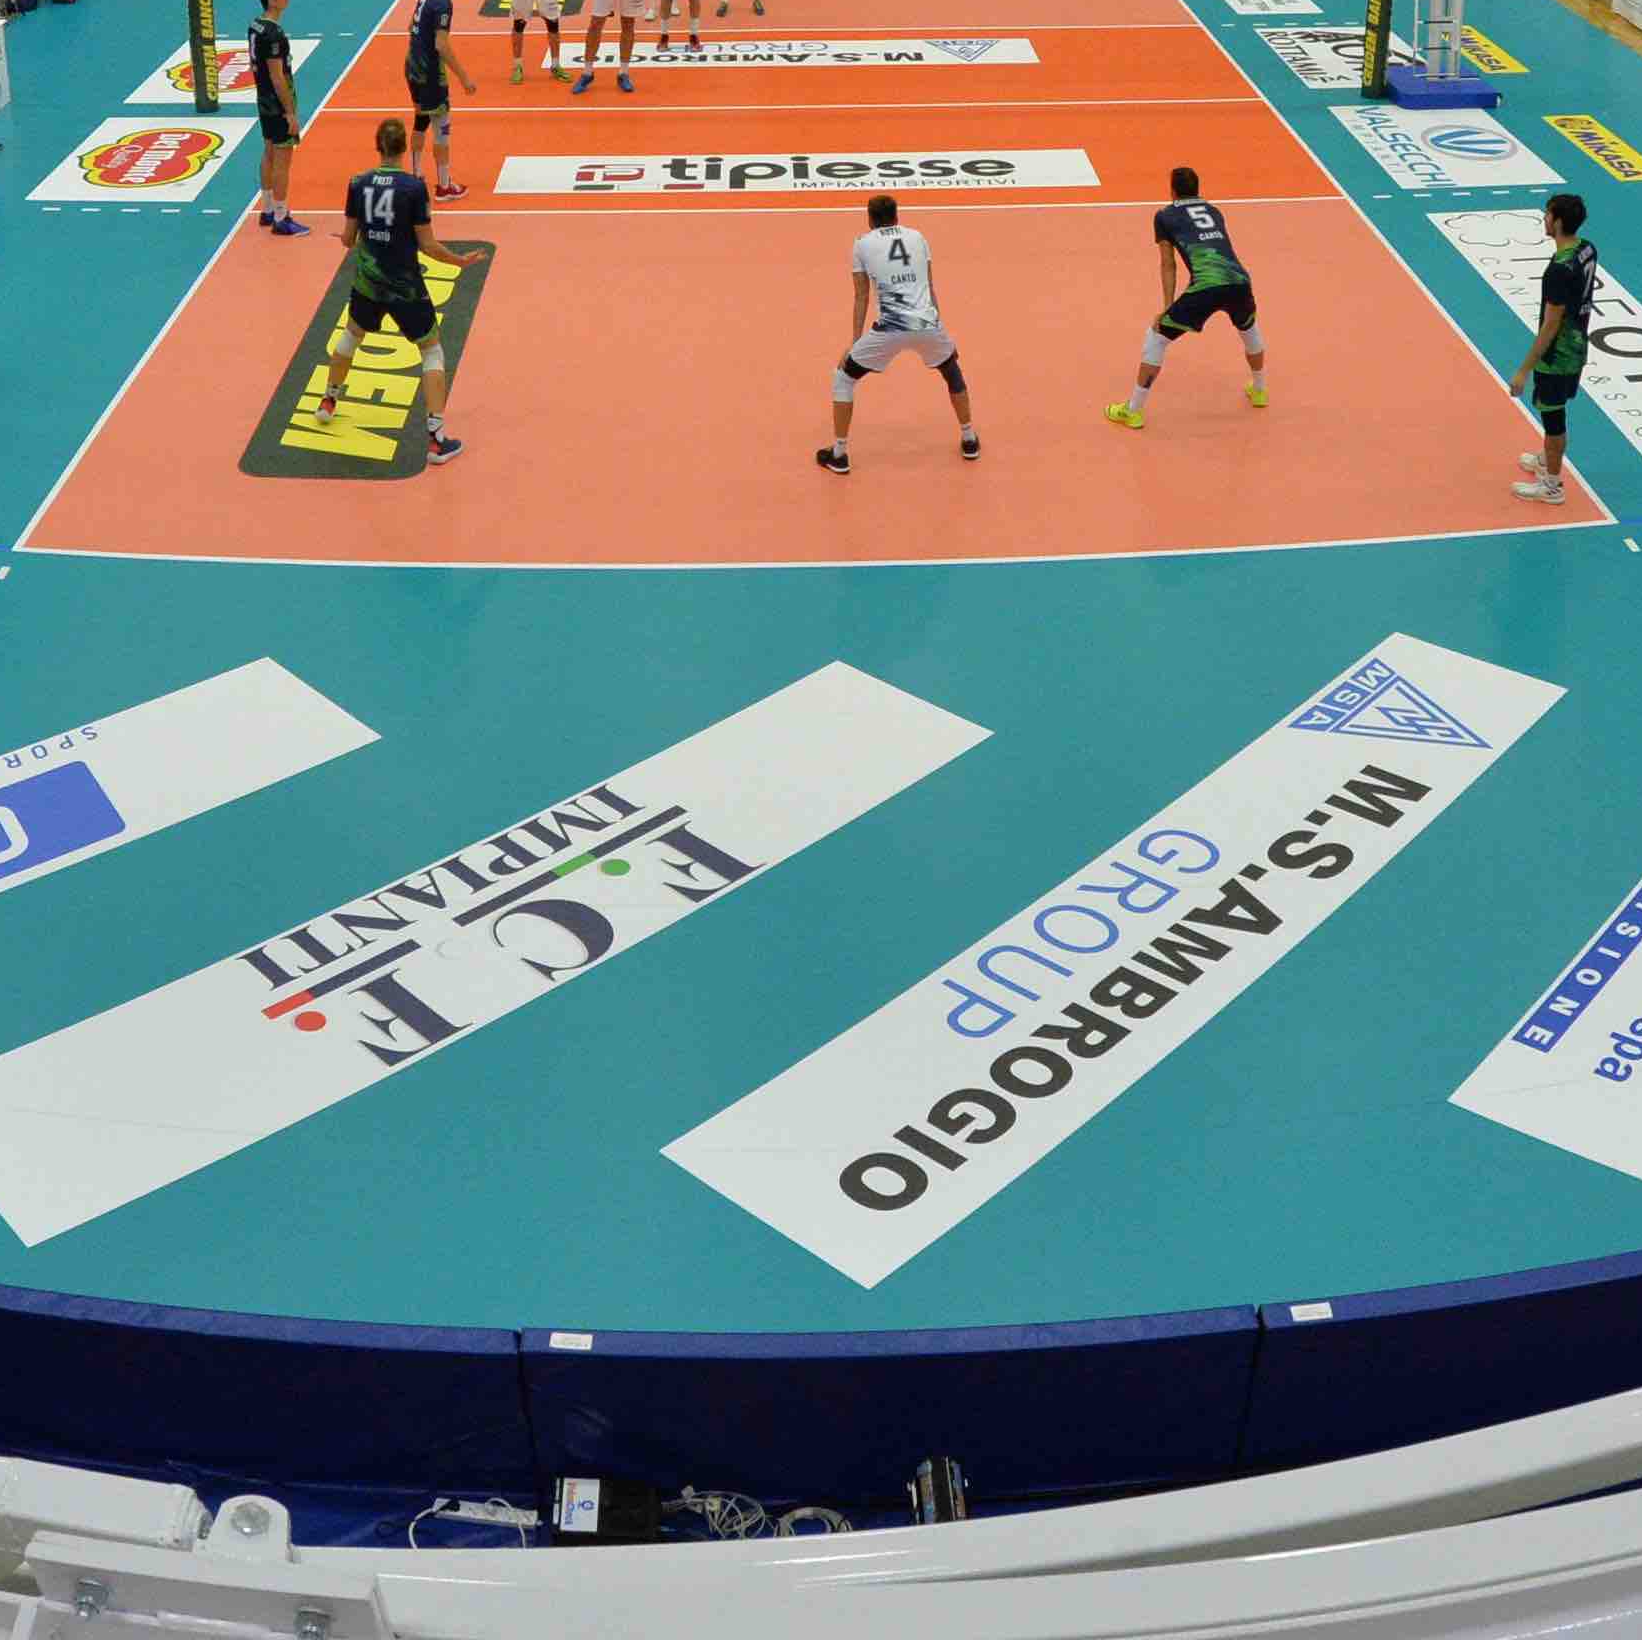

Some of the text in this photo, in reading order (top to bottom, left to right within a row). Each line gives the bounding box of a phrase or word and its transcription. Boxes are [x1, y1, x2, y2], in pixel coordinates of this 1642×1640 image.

[662, 156, 1016, 189] tipiesse
[793, 178, 1017, 189] IMPIANTI SPORTIVI
[363, 186, 395, 227] 14
[1187, 205, 1215, 229] 5
[888, 238, 912, 267] 4
[236, 784, 648, 992] IMPIANTI
[940, 829, 1221, 1040] GROUP
[838, 763, 1433, 1212] M.S.AMBROGIO
